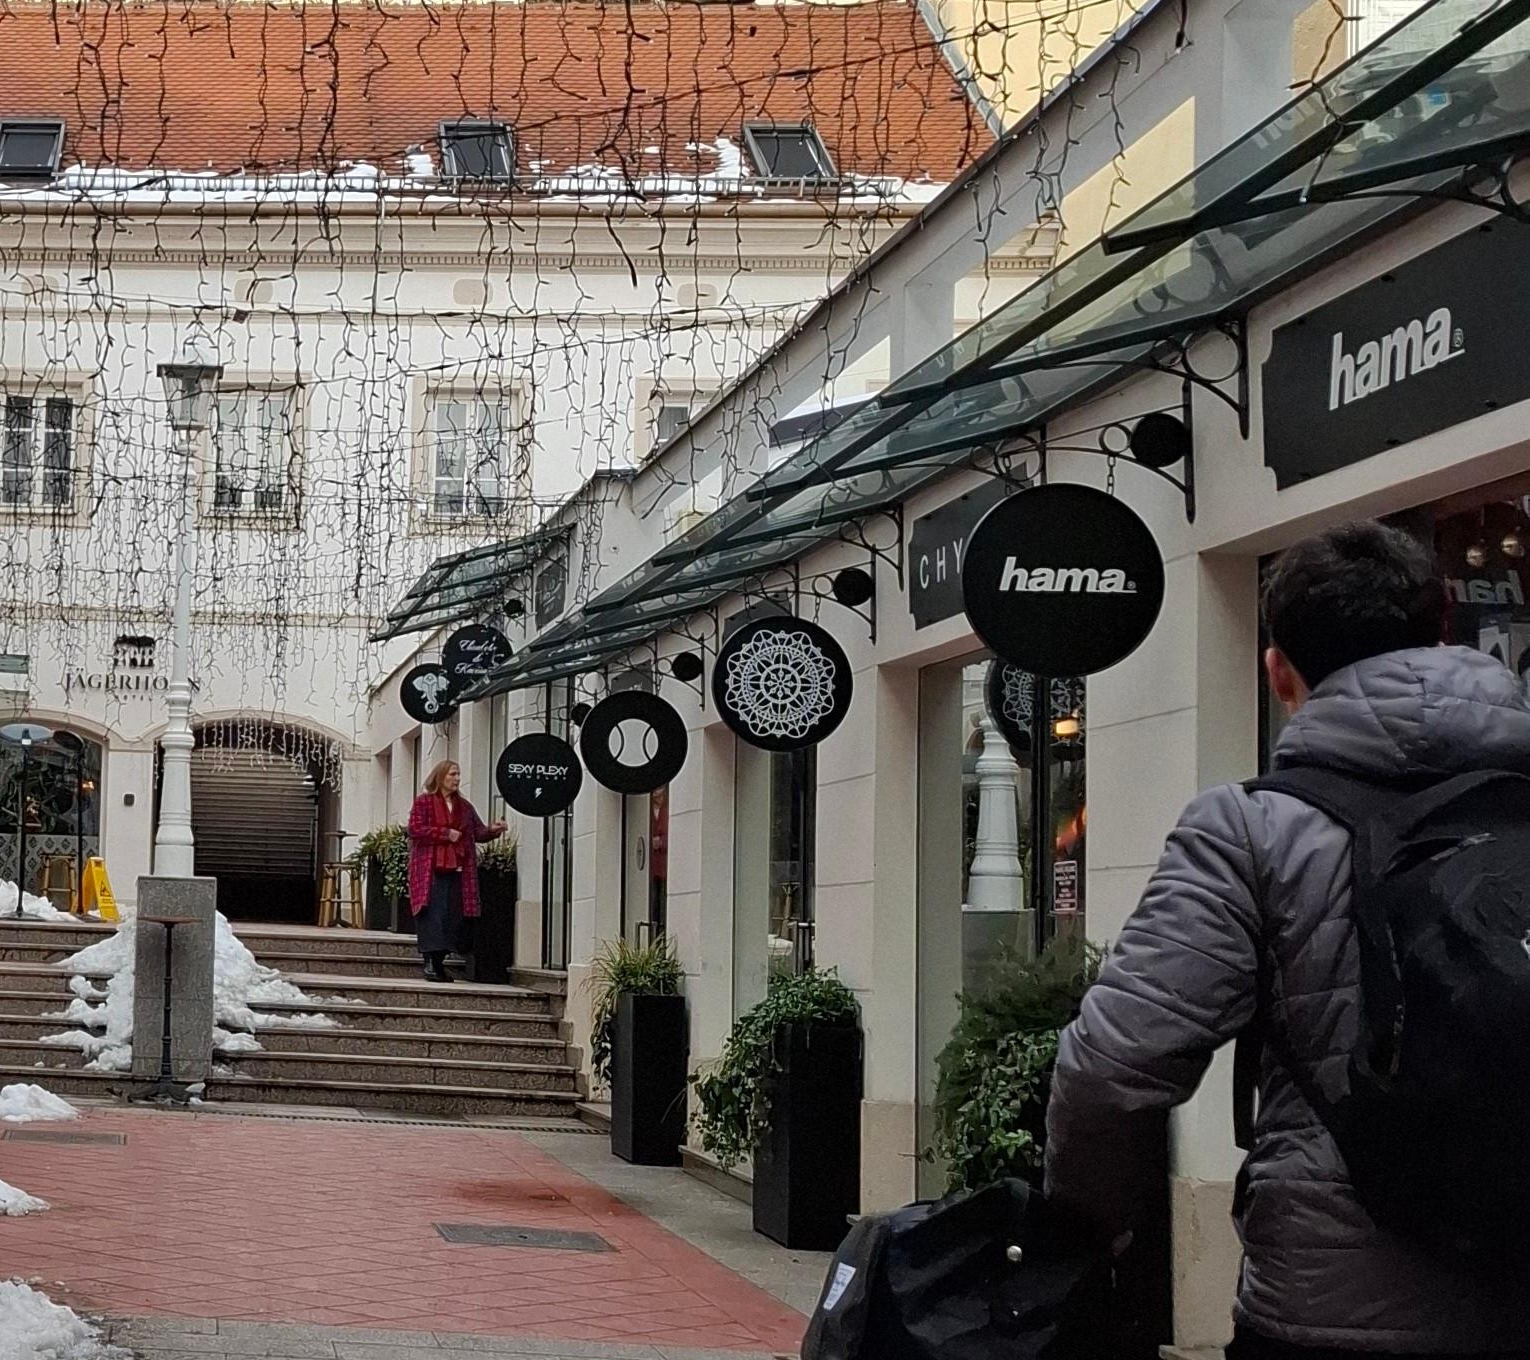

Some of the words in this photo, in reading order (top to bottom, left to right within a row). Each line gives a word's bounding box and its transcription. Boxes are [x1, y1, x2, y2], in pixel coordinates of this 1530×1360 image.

[1328, 307, 1454, 411] hama
[919, 538, 965, 589] CHY
[999, 556, 1128, 593] hama
[65, 667, 201, 691] JÄGERHON
[508, 763, 535, 774] SEXY
[537, 765, 569, 775] PLEXY
